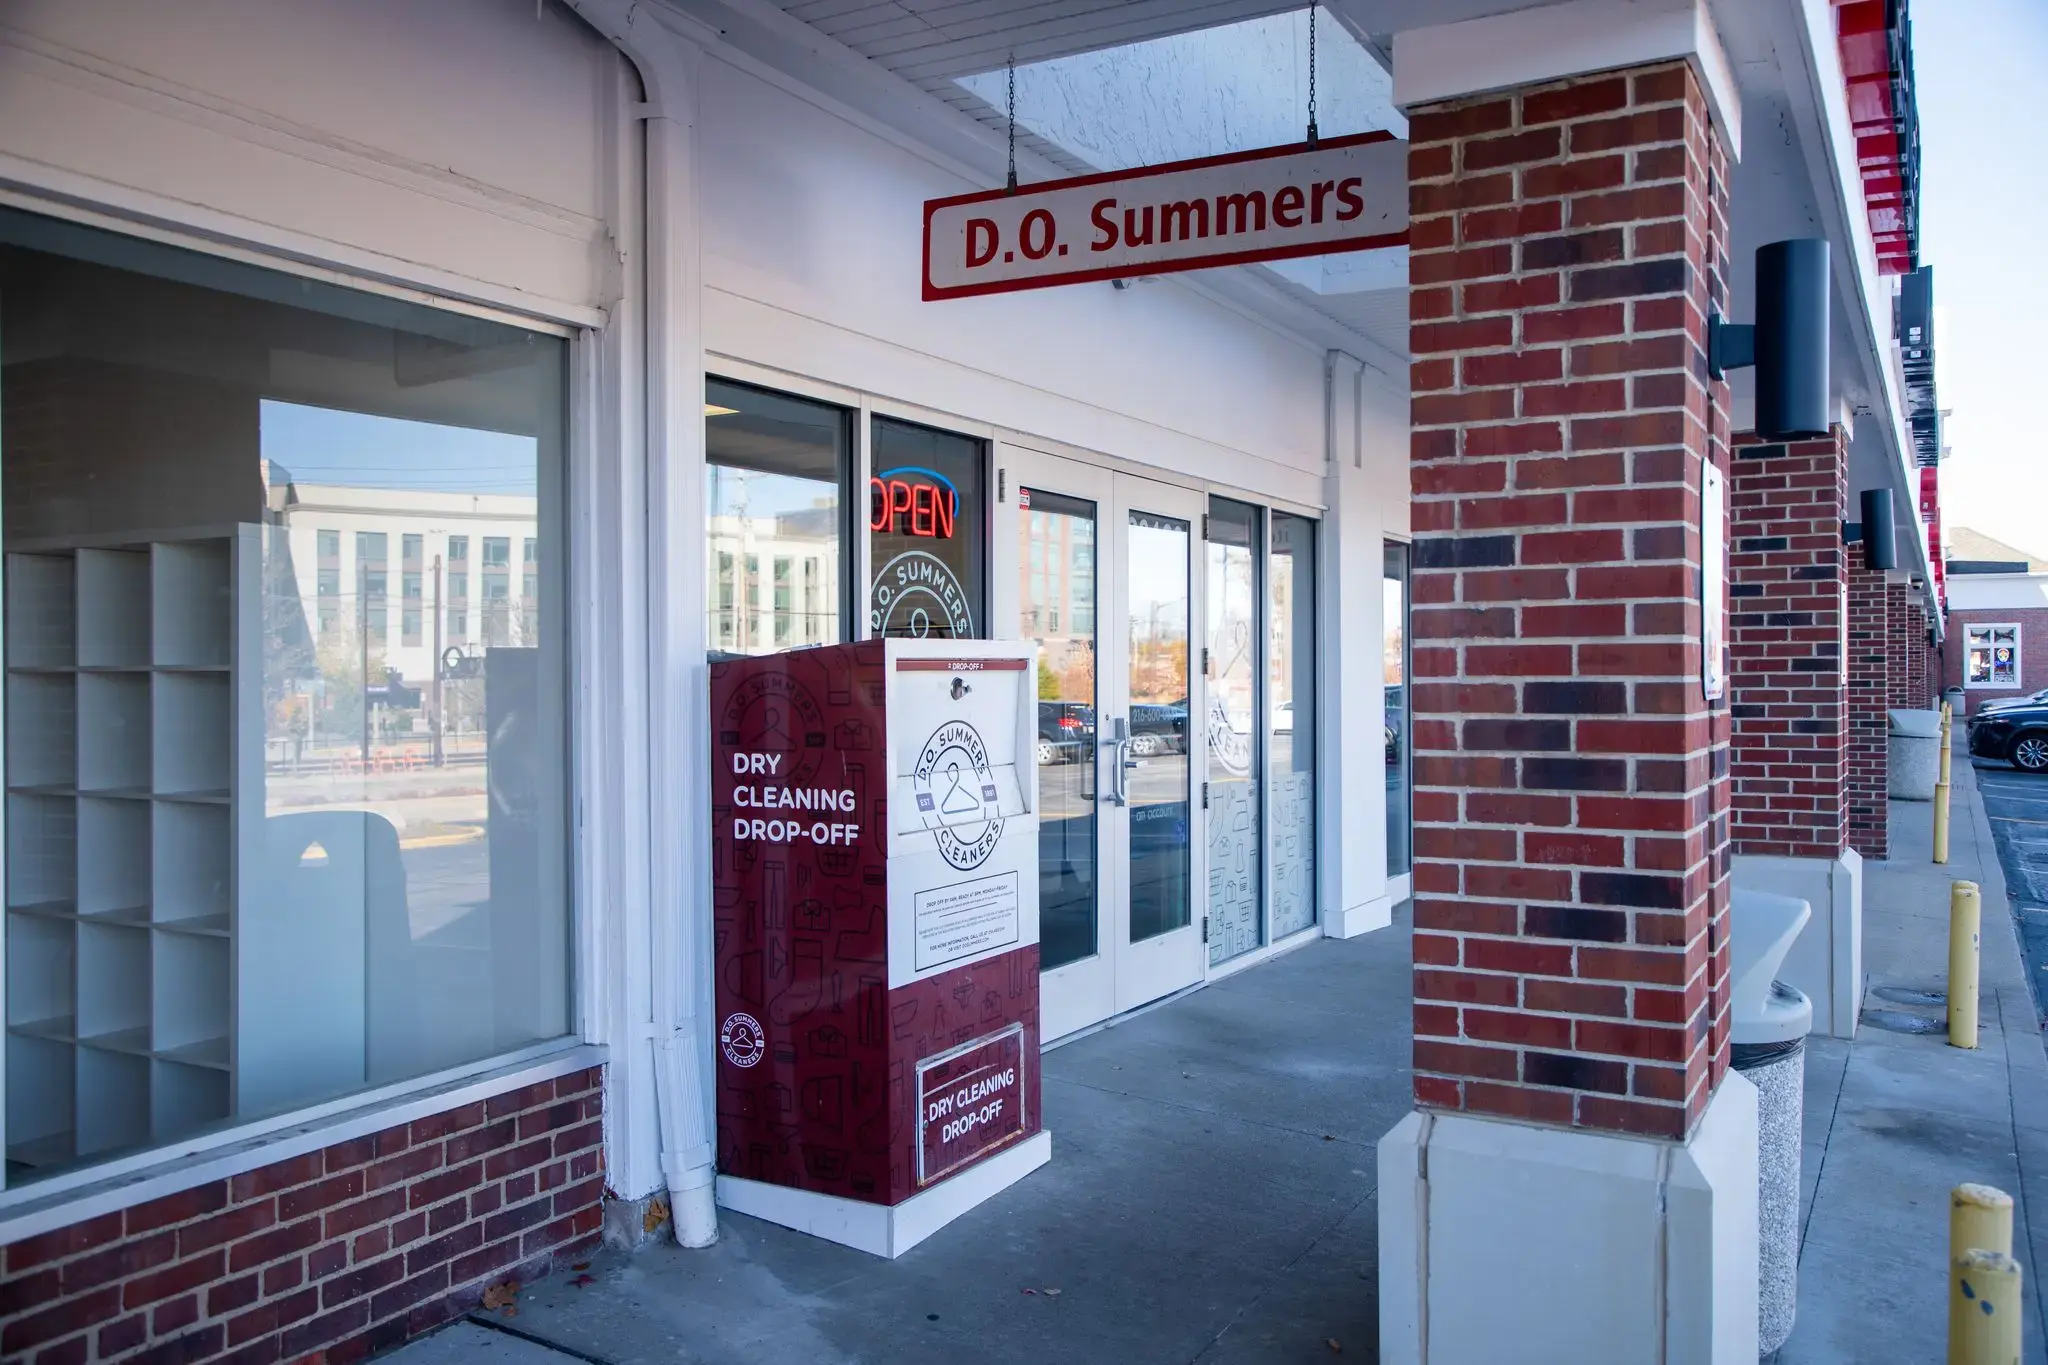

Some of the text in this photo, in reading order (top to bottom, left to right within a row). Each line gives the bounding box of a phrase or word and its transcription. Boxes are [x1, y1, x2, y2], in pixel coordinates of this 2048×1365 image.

[965, 176, 1365, 269] D.O. Summers
[871, 477, 954, 538] OPEN
[896, 561, 968, 634] SUMMERS
[952, 662, 980, 671] DROP-OFF
[734, 753, 781, 774] DRY
[917, 727, 985, 781] D.O. SUMMERS
[733, 785, 856, 812] CLEANING
[734, 818, 859, 846] DROP-OFF
[940, 821, 999, 864] CLEANERS
[734, 1016, 761, 1037] SUMMERS
[727, 1048, 759, 1065] CLEANERS
[929, 1068, 1014, 1121] DRY CLEANING
[943, 1099, 1002, 1143] DROP-OFF
